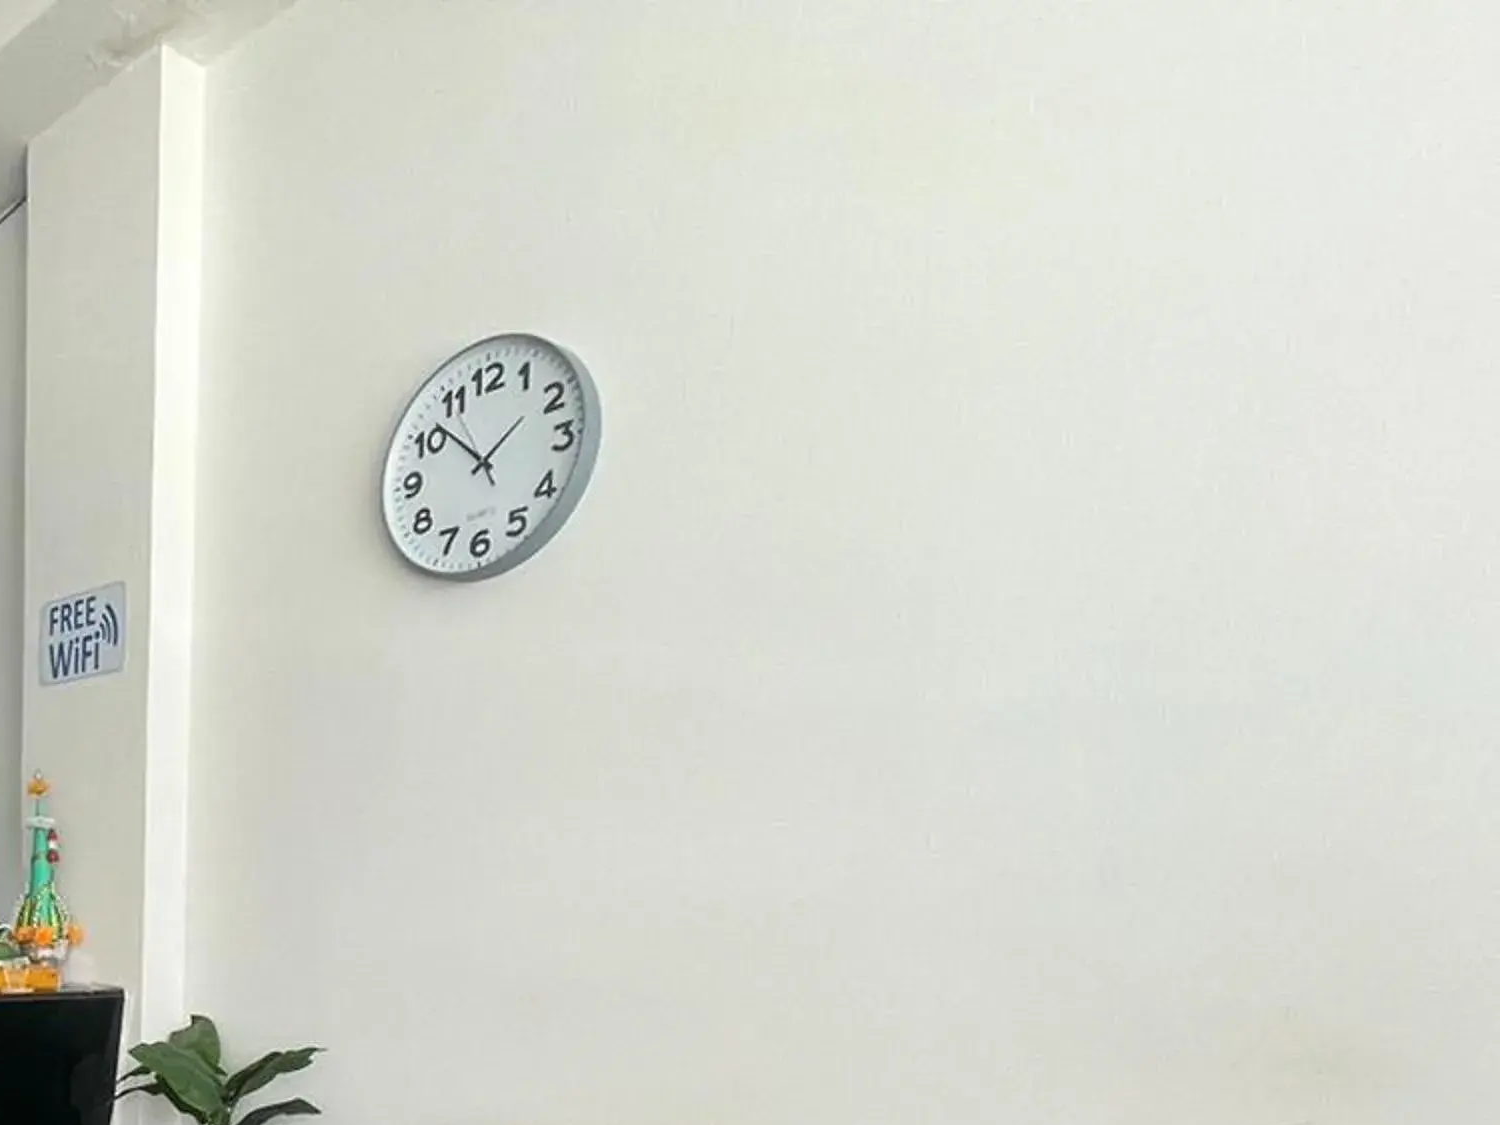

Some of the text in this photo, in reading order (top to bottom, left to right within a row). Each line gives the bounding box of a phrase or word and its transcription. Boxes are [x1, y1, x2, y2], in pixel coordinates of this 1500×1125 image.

[471, 362, 505, 396] 12
[517, 361, 531, 391] 1
[441, 385, 467, 418] 11
[543, 382, 565, 414] 2
[414, 425, 447, 459] 10
[551, 419, 575, 452] 3
[403, 471, 423, 499] 9
[534, 469, 557, 499] 4
[412, 507, 433, 535] 8
[505, 506, 529, 537] 5
[438, 526, 460, 556] 7
[469, 528, 490, 558] 6
[49, 596, 96, 636] FREE
[48, 631, 100, 679] WiFi
